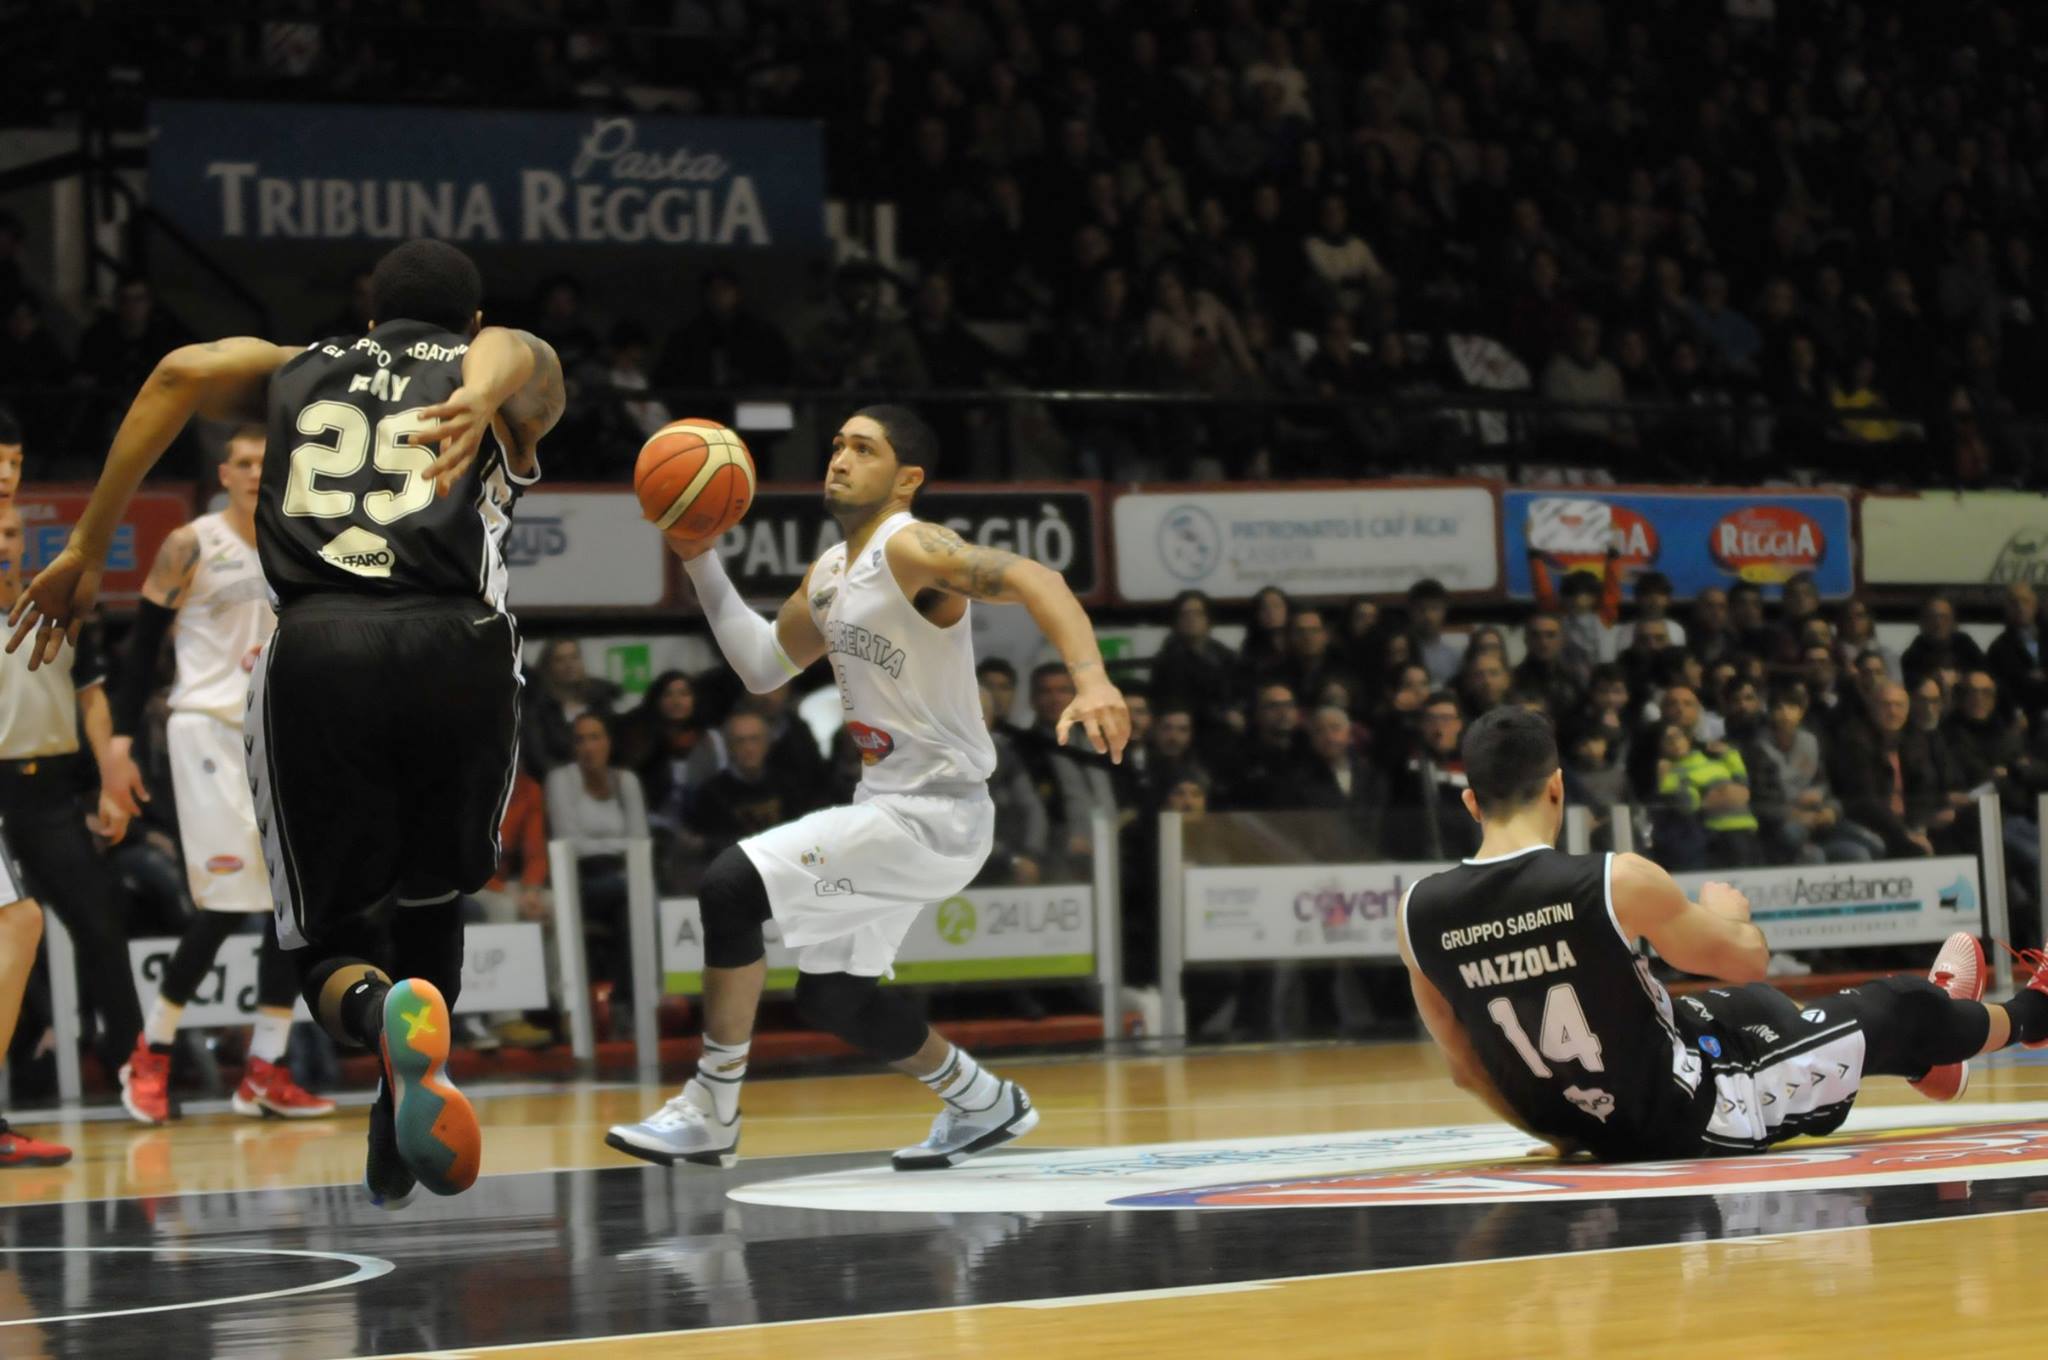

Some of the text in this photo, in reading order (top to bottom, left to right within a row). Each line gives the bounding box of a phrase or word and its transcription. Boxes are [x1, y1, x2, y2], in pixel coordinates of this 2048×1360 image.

[572, 118, 727, 177] Pasta
[206, 162, 769, 245] TRIBUNA REGGIA
[283, 400, 437, 524] 25
[1441, 902, 1573, 950] GRUPPO SABATINI
[1459, 940, 1577, 989] MAZZOLA
[1488, 983, 1604, 1078] 14
